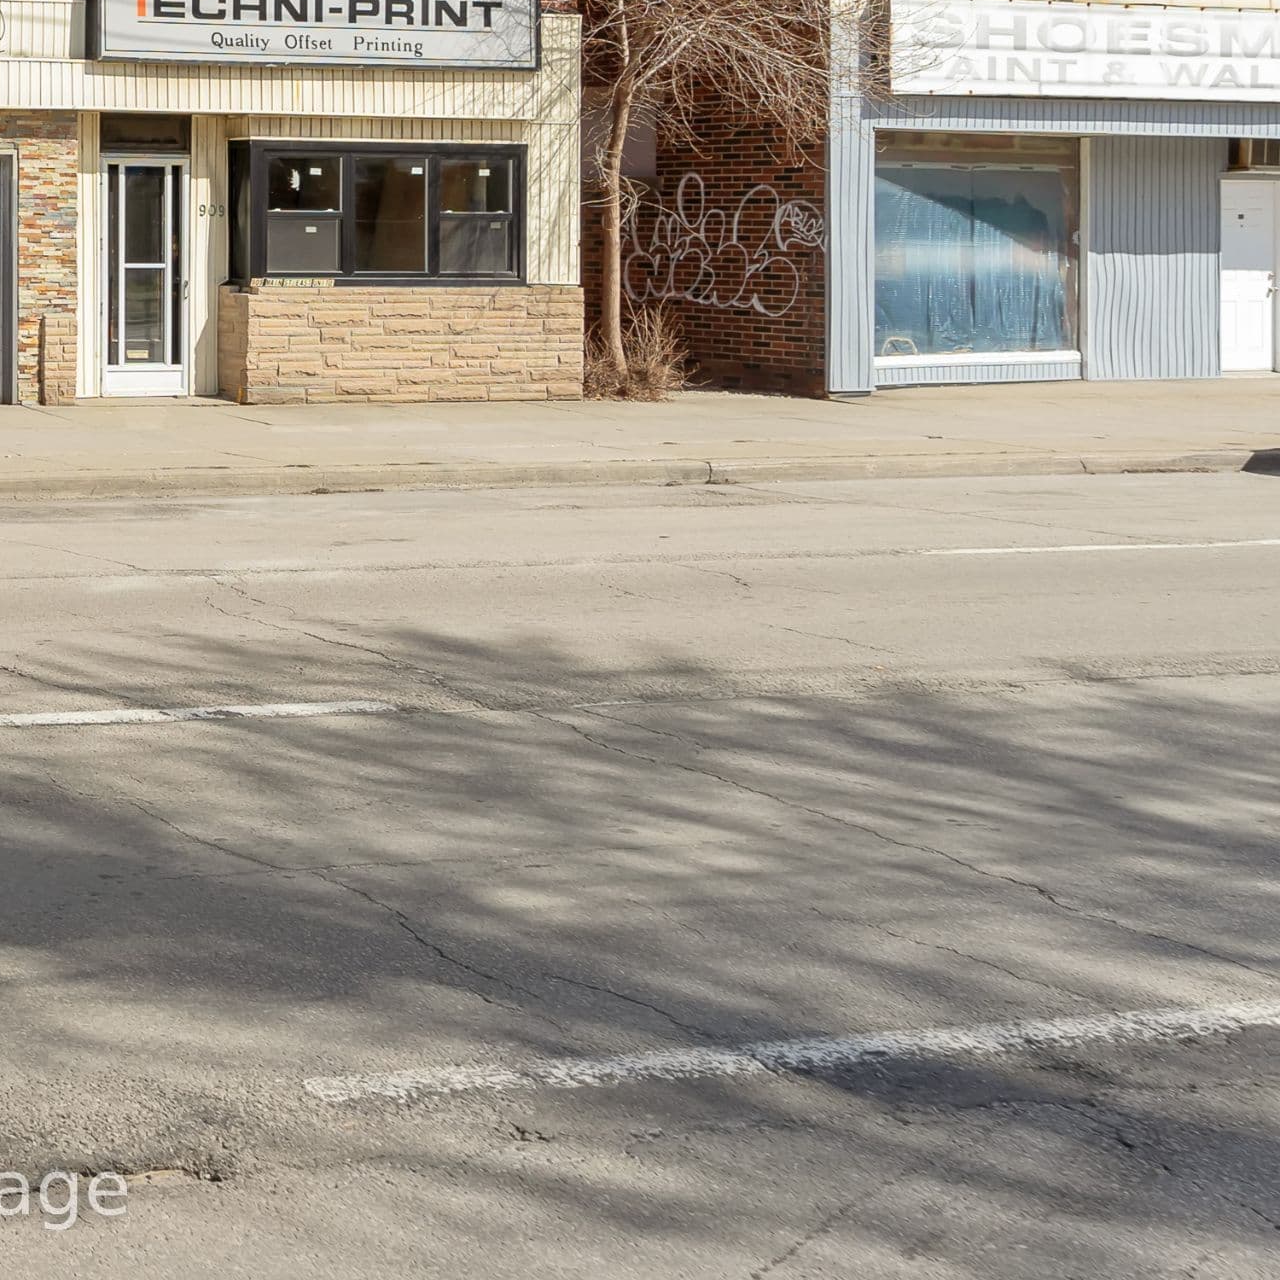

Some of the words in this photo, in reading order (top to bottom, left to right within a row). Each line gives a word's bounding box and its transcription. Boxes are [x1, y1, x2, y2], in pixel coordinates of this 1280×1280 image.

[211, 31, 270, 51] Quality
[284, 34, 333, 50] Offset
[353, 36, 424, 57] Printing
[199, 204, 225, 218] 909
